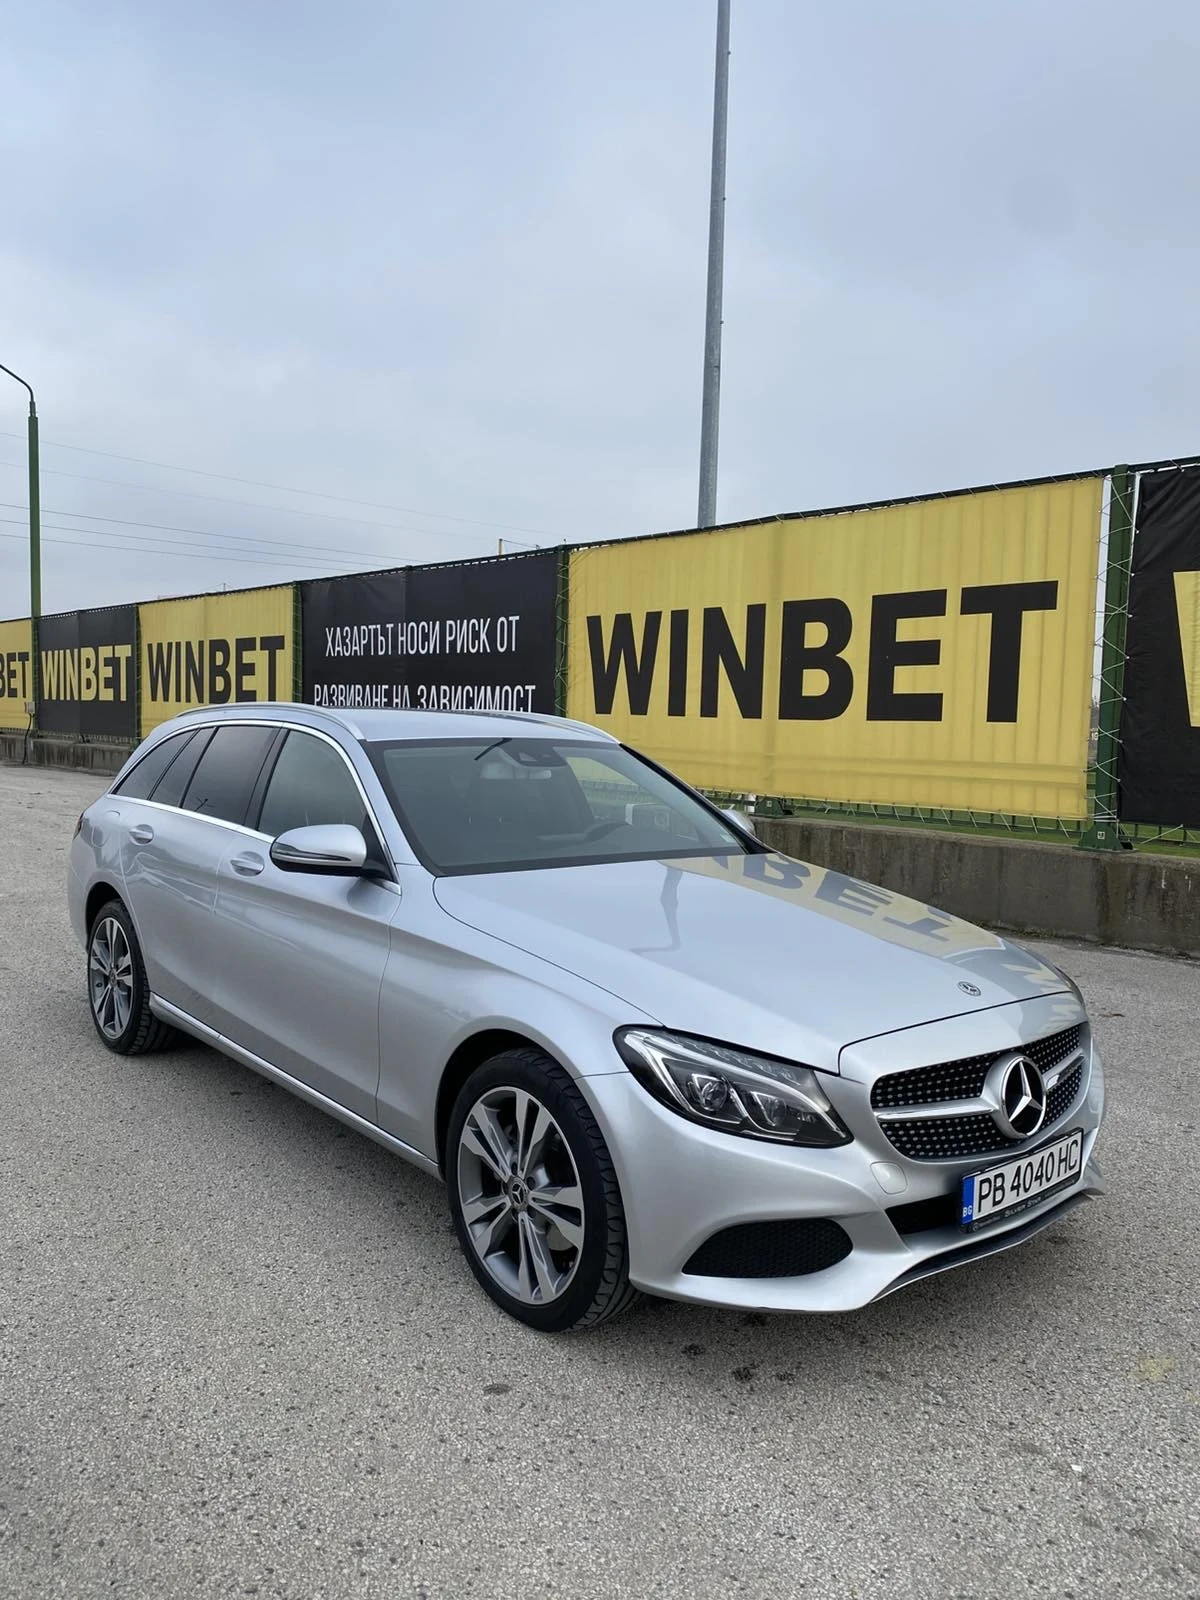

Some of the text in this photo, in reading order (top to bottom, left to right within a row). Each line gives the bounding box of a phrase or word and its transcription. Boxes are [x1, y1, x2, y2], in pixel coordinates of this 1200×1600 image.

[325, 615, 520, 657] ХАЗАРТЪТ НОСИ РИСК ОТ
[586, 580, 1058, 723] WINBET
[41, 644, 132, 701] WINBET
[147, 635, 285, 704] WINBET
[978, 1172, 1005, 1212] PB
[1010, 1151, 1054, 1195] 4040
[1057, 1139, 1078, 1176] HC
[962, 1204, 973, 1217] BG
